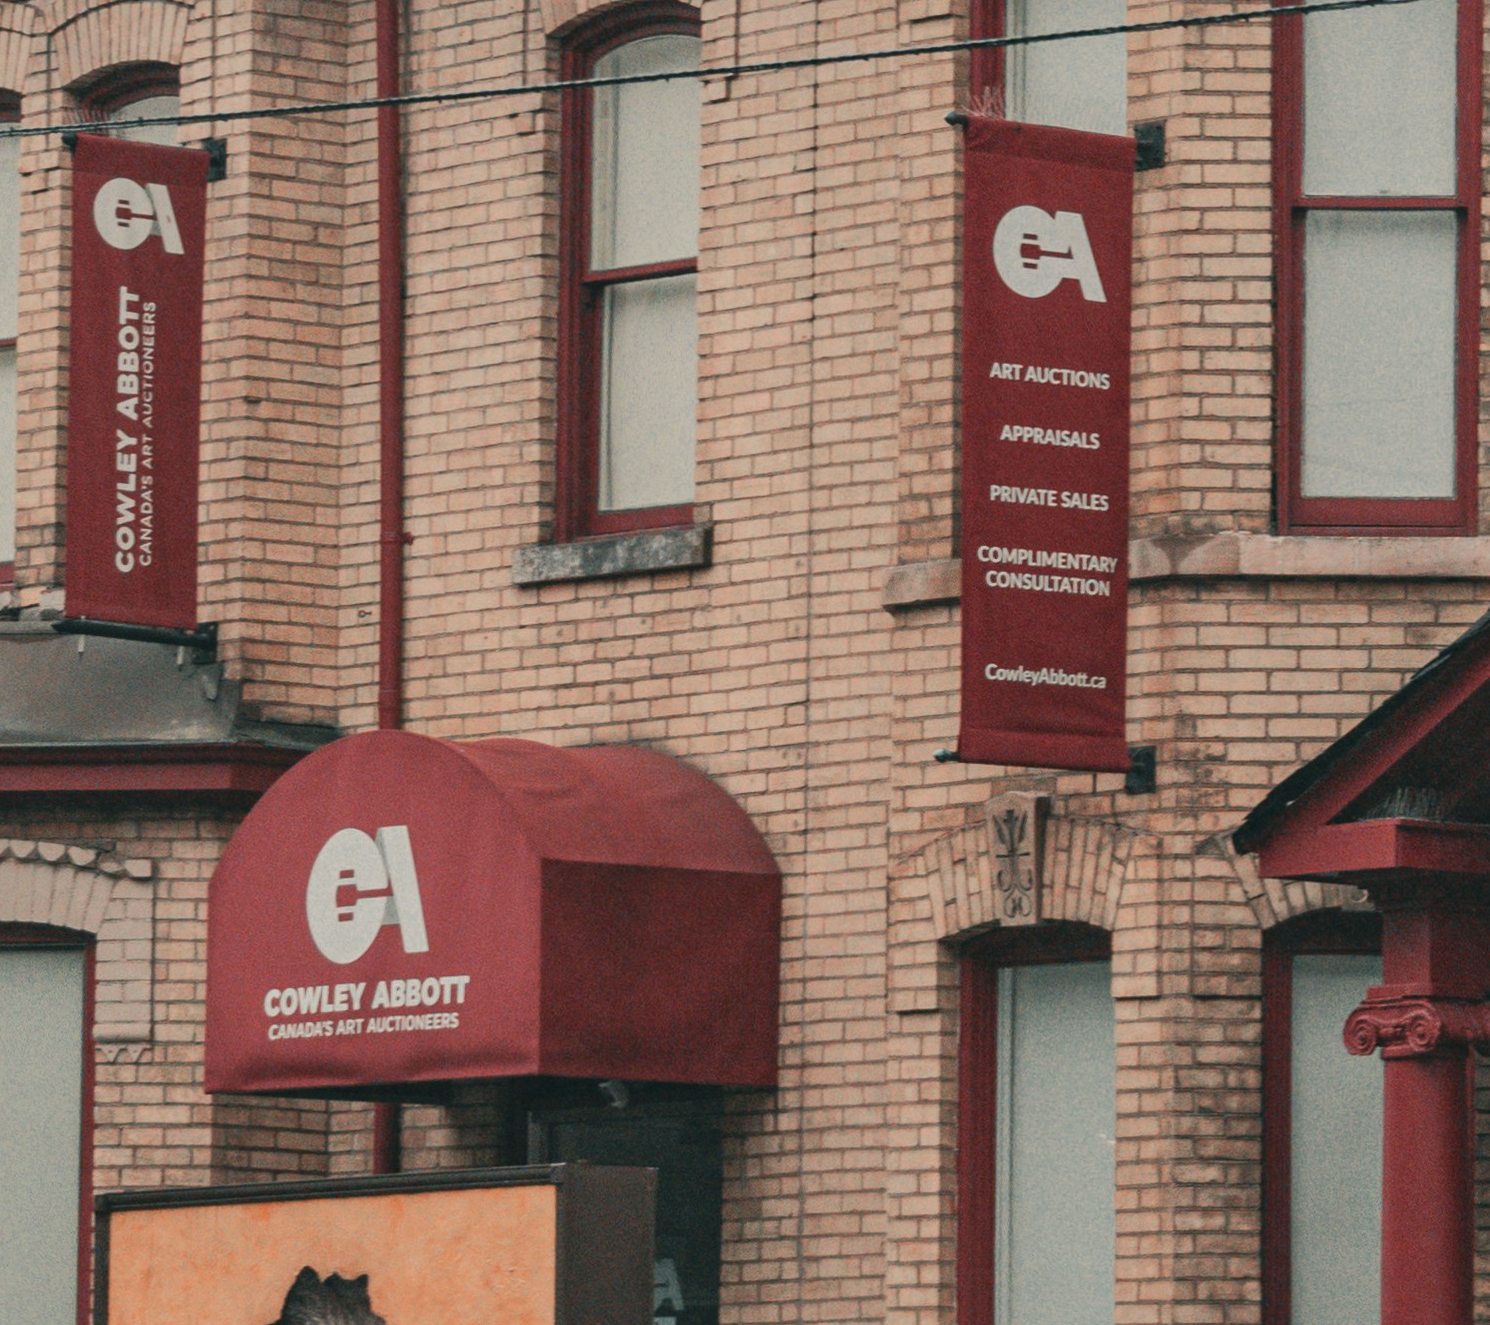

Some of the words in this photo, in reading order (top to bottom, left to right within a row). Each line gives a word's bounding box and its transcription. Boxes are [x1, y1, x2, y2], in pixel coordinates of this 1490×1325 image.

[117, 286, 141, 421] ABBOTT
[141, 301, 158, 429] AUCTIONEERS
[989, 361, 1022, 382] ART
[1024, 364, 1111, 390] AUCTIONS
[140, 435, 154, 470] ART
[999, 424, 1100, 450] APPRAISALS
[114, 428, 139, 573] COWLEY
[989, 484, 1058, 509] PRIVATE
[1060, 490, 1110, 512] SALES
[138, 473, 154, 568] CANADA'S
[976, 545, 1119, 574] COMPLIMENTARY
[985, 570, 1111, 597] CONSULTATION
[984, 662, 1107, 690] CowleyAbbott.ca
[263, 981, 367, 1017] COWLEY
[371, 975, 471, 1011] ABBOTT
[267, 1019, 334, 1042] CANADA'S
[335, 1017, 365, 1037] ART
[366, 1011, 460, 1036] AUCTIONEERS
